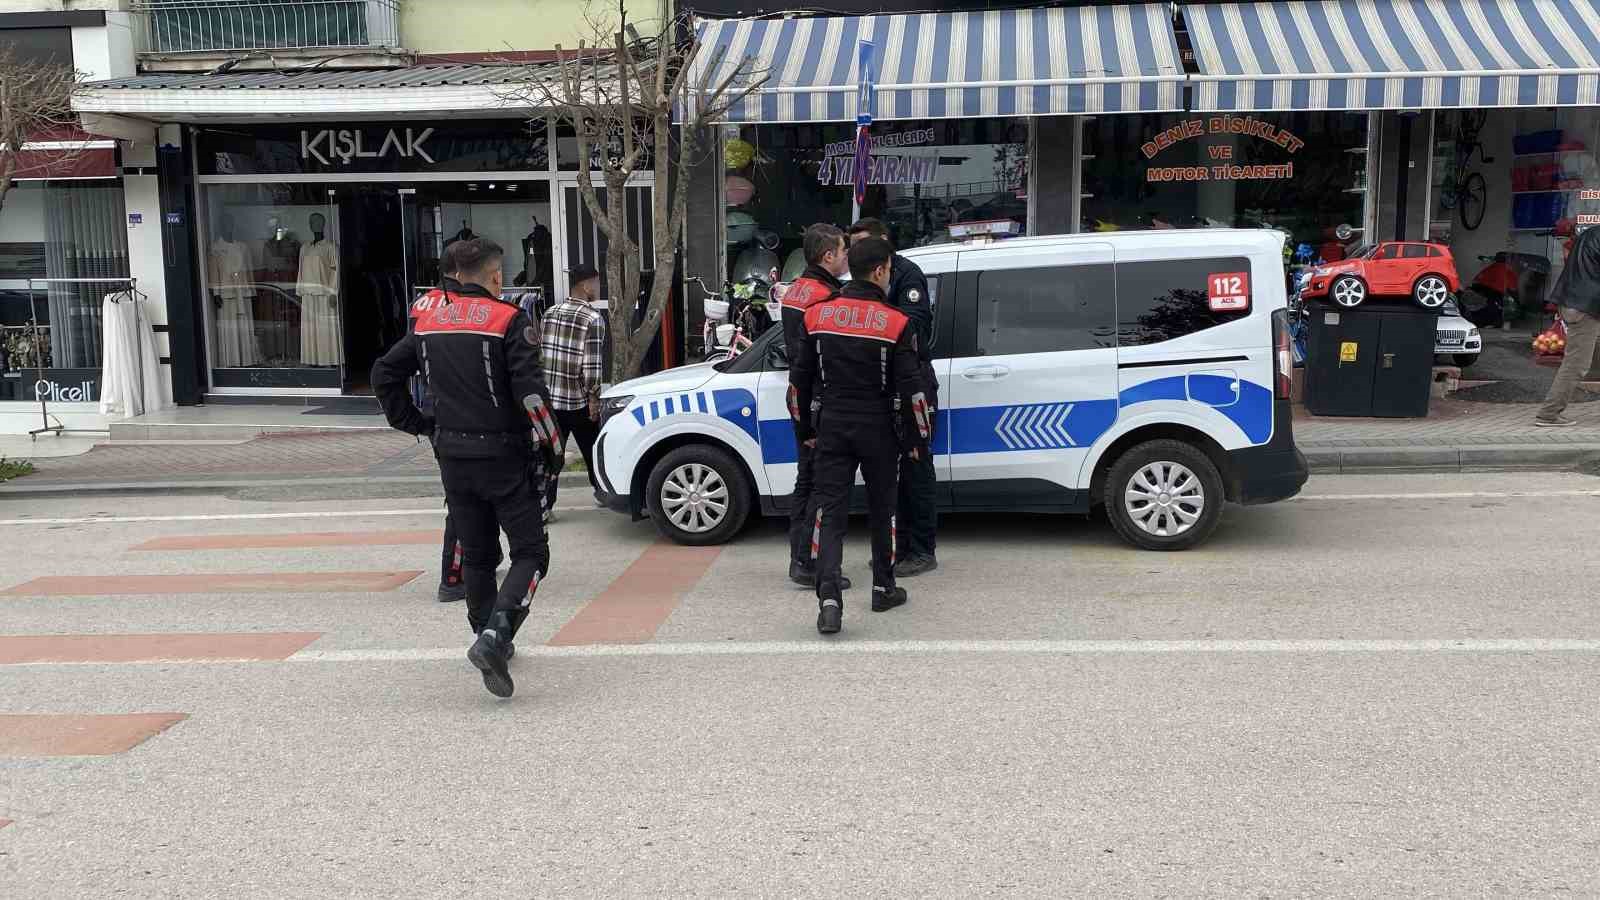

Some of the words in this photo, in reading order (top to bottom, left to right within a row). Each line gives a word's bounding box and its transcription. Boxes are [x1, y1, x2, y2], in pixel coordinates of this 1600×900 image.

[301, 127, 436, 165] KIŞLAK
[1141, 119, 1205, 159] DENİZ
[1209, 114, 1305, 154] BİSİKLET
[1208, 146, 1233, 159] VE
[817, 157, 832, 185] 4
[1147, 167, 1208, 181] MOTOR
[1214, 162, 1293, 180] TİCARETİ
[1214, 276, 1243, 297] 112
[816, 304, 889, 331] POLİS
[35, 379, 92, 401] Plicell
